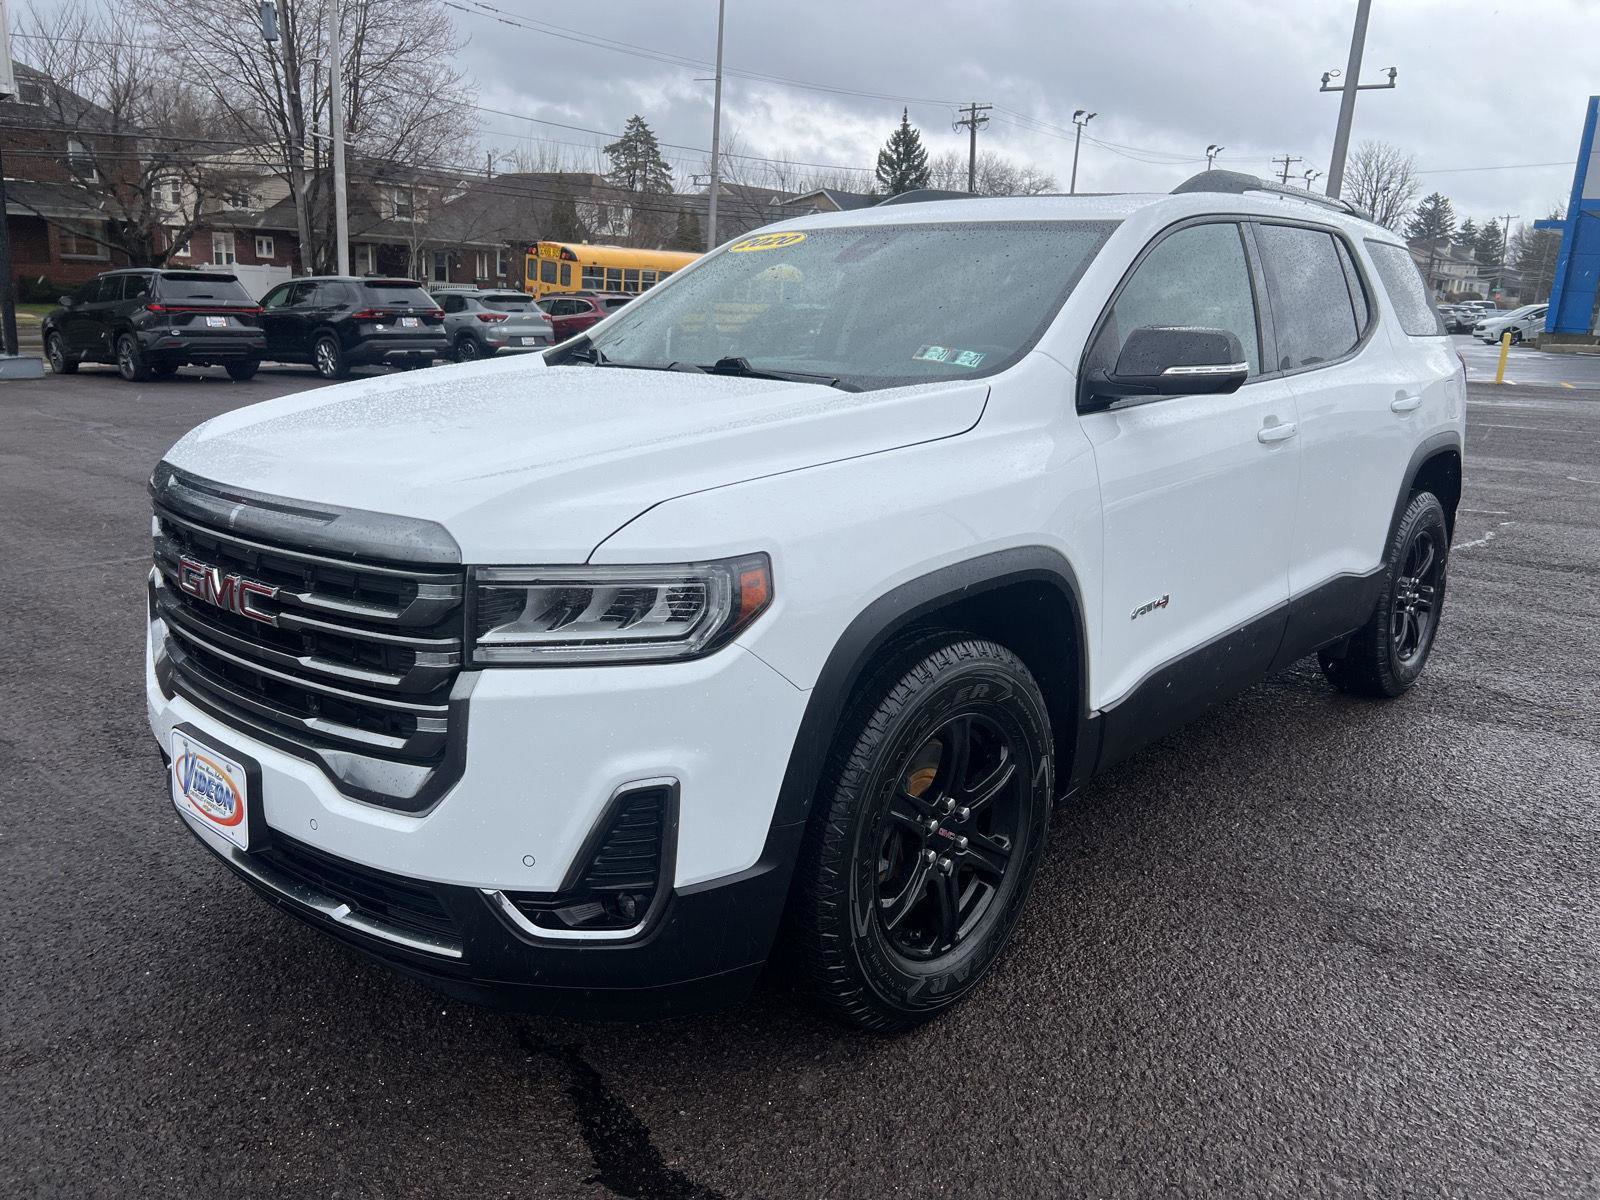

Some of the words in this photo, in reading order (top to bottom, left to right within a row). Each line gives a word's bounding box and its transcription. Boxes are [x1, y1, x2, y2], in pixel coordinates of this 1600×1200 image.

[178, 555, 279, 628] GMC
[184, 746, 236, 814] VIDEON
[938, 827, 956, 841] GMC
